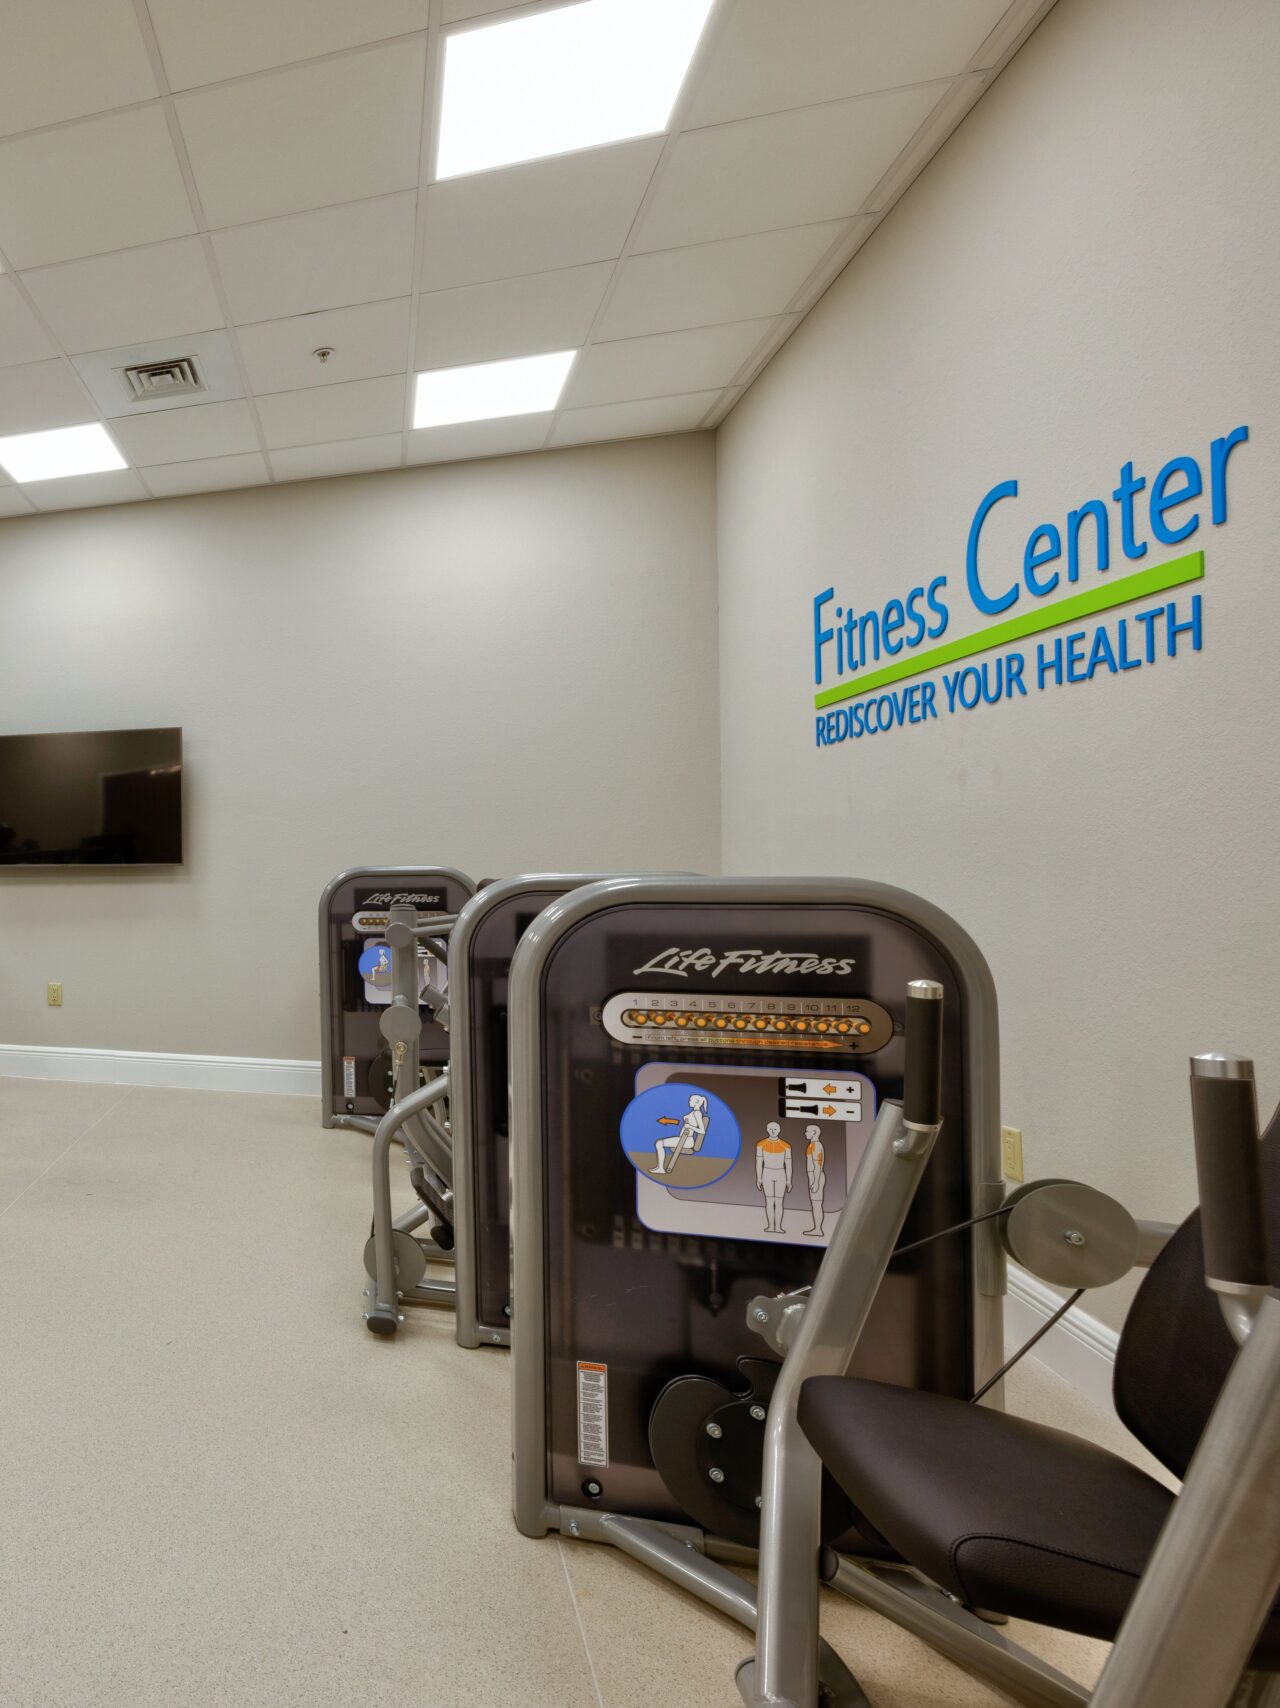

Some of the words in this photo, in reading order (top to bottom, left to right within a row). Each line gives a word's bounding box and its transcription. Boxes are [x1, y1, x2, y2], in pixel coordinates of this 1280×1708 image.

[813, 575, 949, 685] Fitness
[966, 425, 1249, 616] Center
[815, 680, 938, 747] REDISCOVER
[942, 652, 1028, 714] YOUR
[1036, 594, 1202, 690] HEALTH
[362, 892, 393, 905] Life
[389, 893, 441, 905] Fitness
[632, 947, 716, 977] Life
[711, 950, 856, 978] Fitness
[847, 1005, 861, 1013] 12
